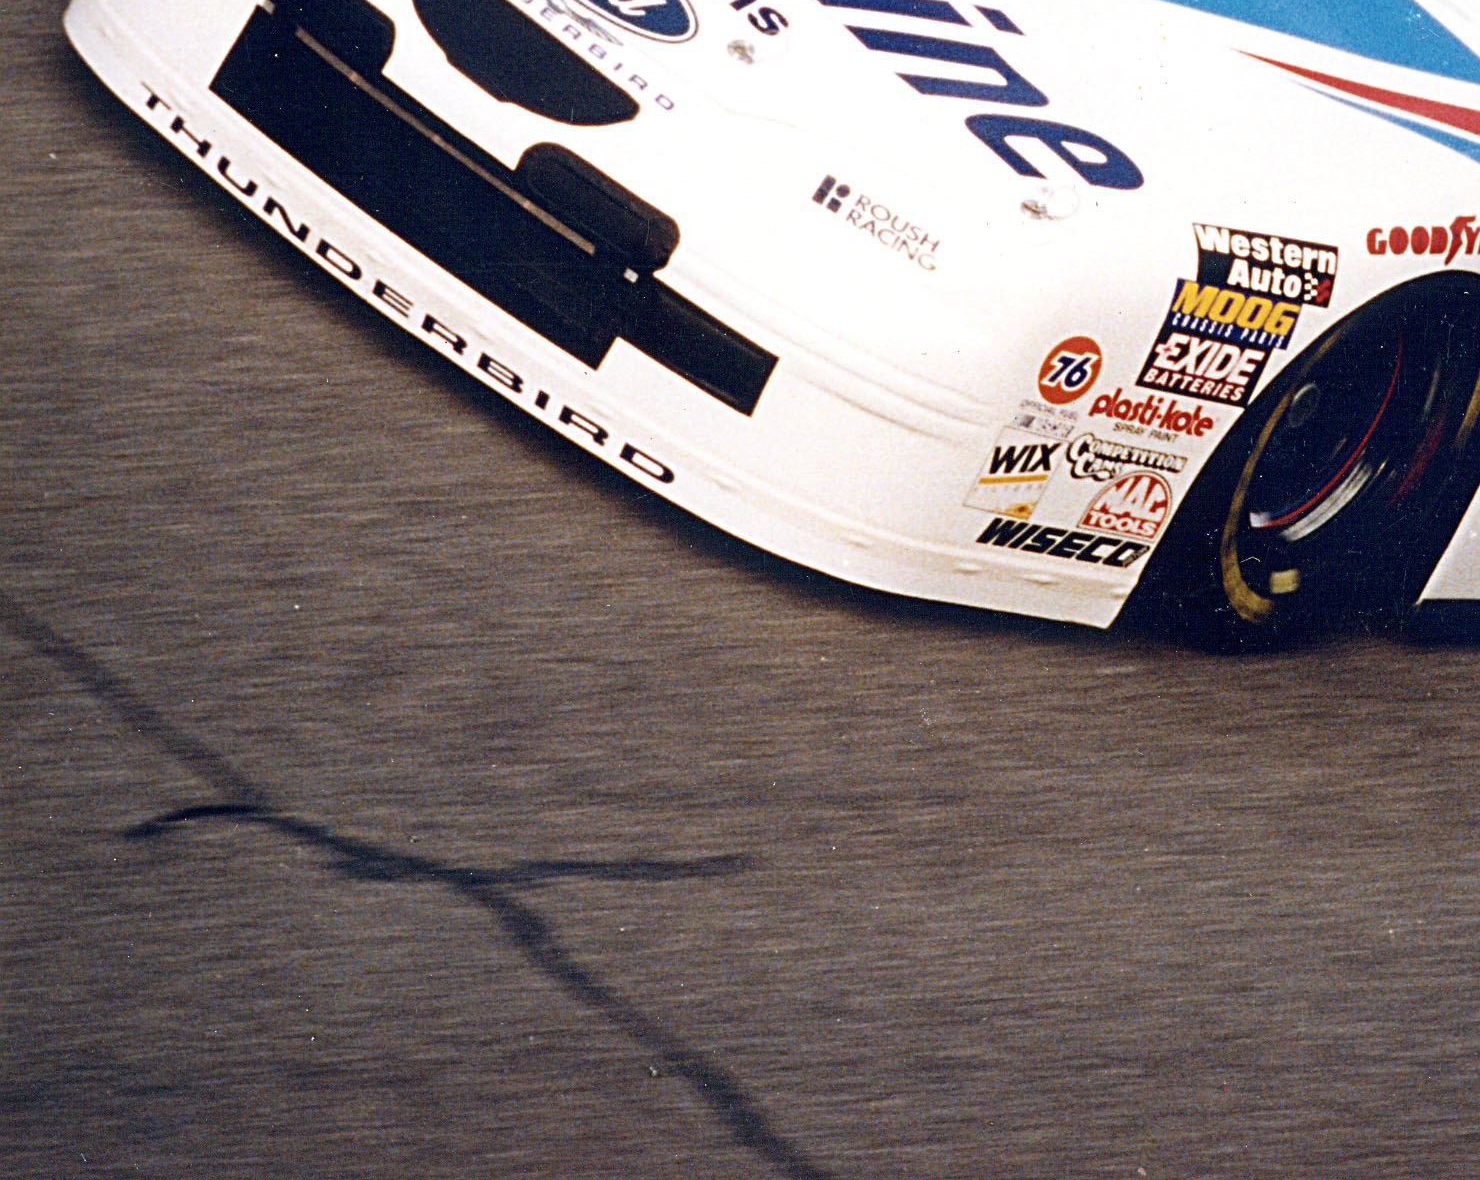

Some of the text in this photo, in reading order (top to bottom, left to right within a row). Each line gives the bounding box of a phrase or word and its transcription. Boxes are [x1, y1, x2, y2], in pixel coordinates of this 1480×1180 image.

[846, 208, 936, 271] RACING
[855, 193, 940, 252] ROUSH
[1194, 224, 1338, 275] Western
[141, 81, 675, 484] THUNDERBIRD
[1226, 258, 1302, 299] Auto
[1172, 281, 1300, 336] MOOG
[1171, 312, 1286, 348] CHASSIS PARTS
[1044, 352, 1097, 388] 76
[1153, 332, 1266, 386] EXIDE
[1143, 368, 1246, 402] BATTERIES
[1088, 387, 1215, 437] plasti-kote
[1066, 433, 1188, 473] COMPETITION
[1112, 422, 1180, 444] SPRAY PAINT
[989, 442, 1062, 475] WIX
[1094, 474, 1167, 515] MAC
[975, 517, 1151, 568] WISECO
[1084, 513, 1158, 537] TOOLS
